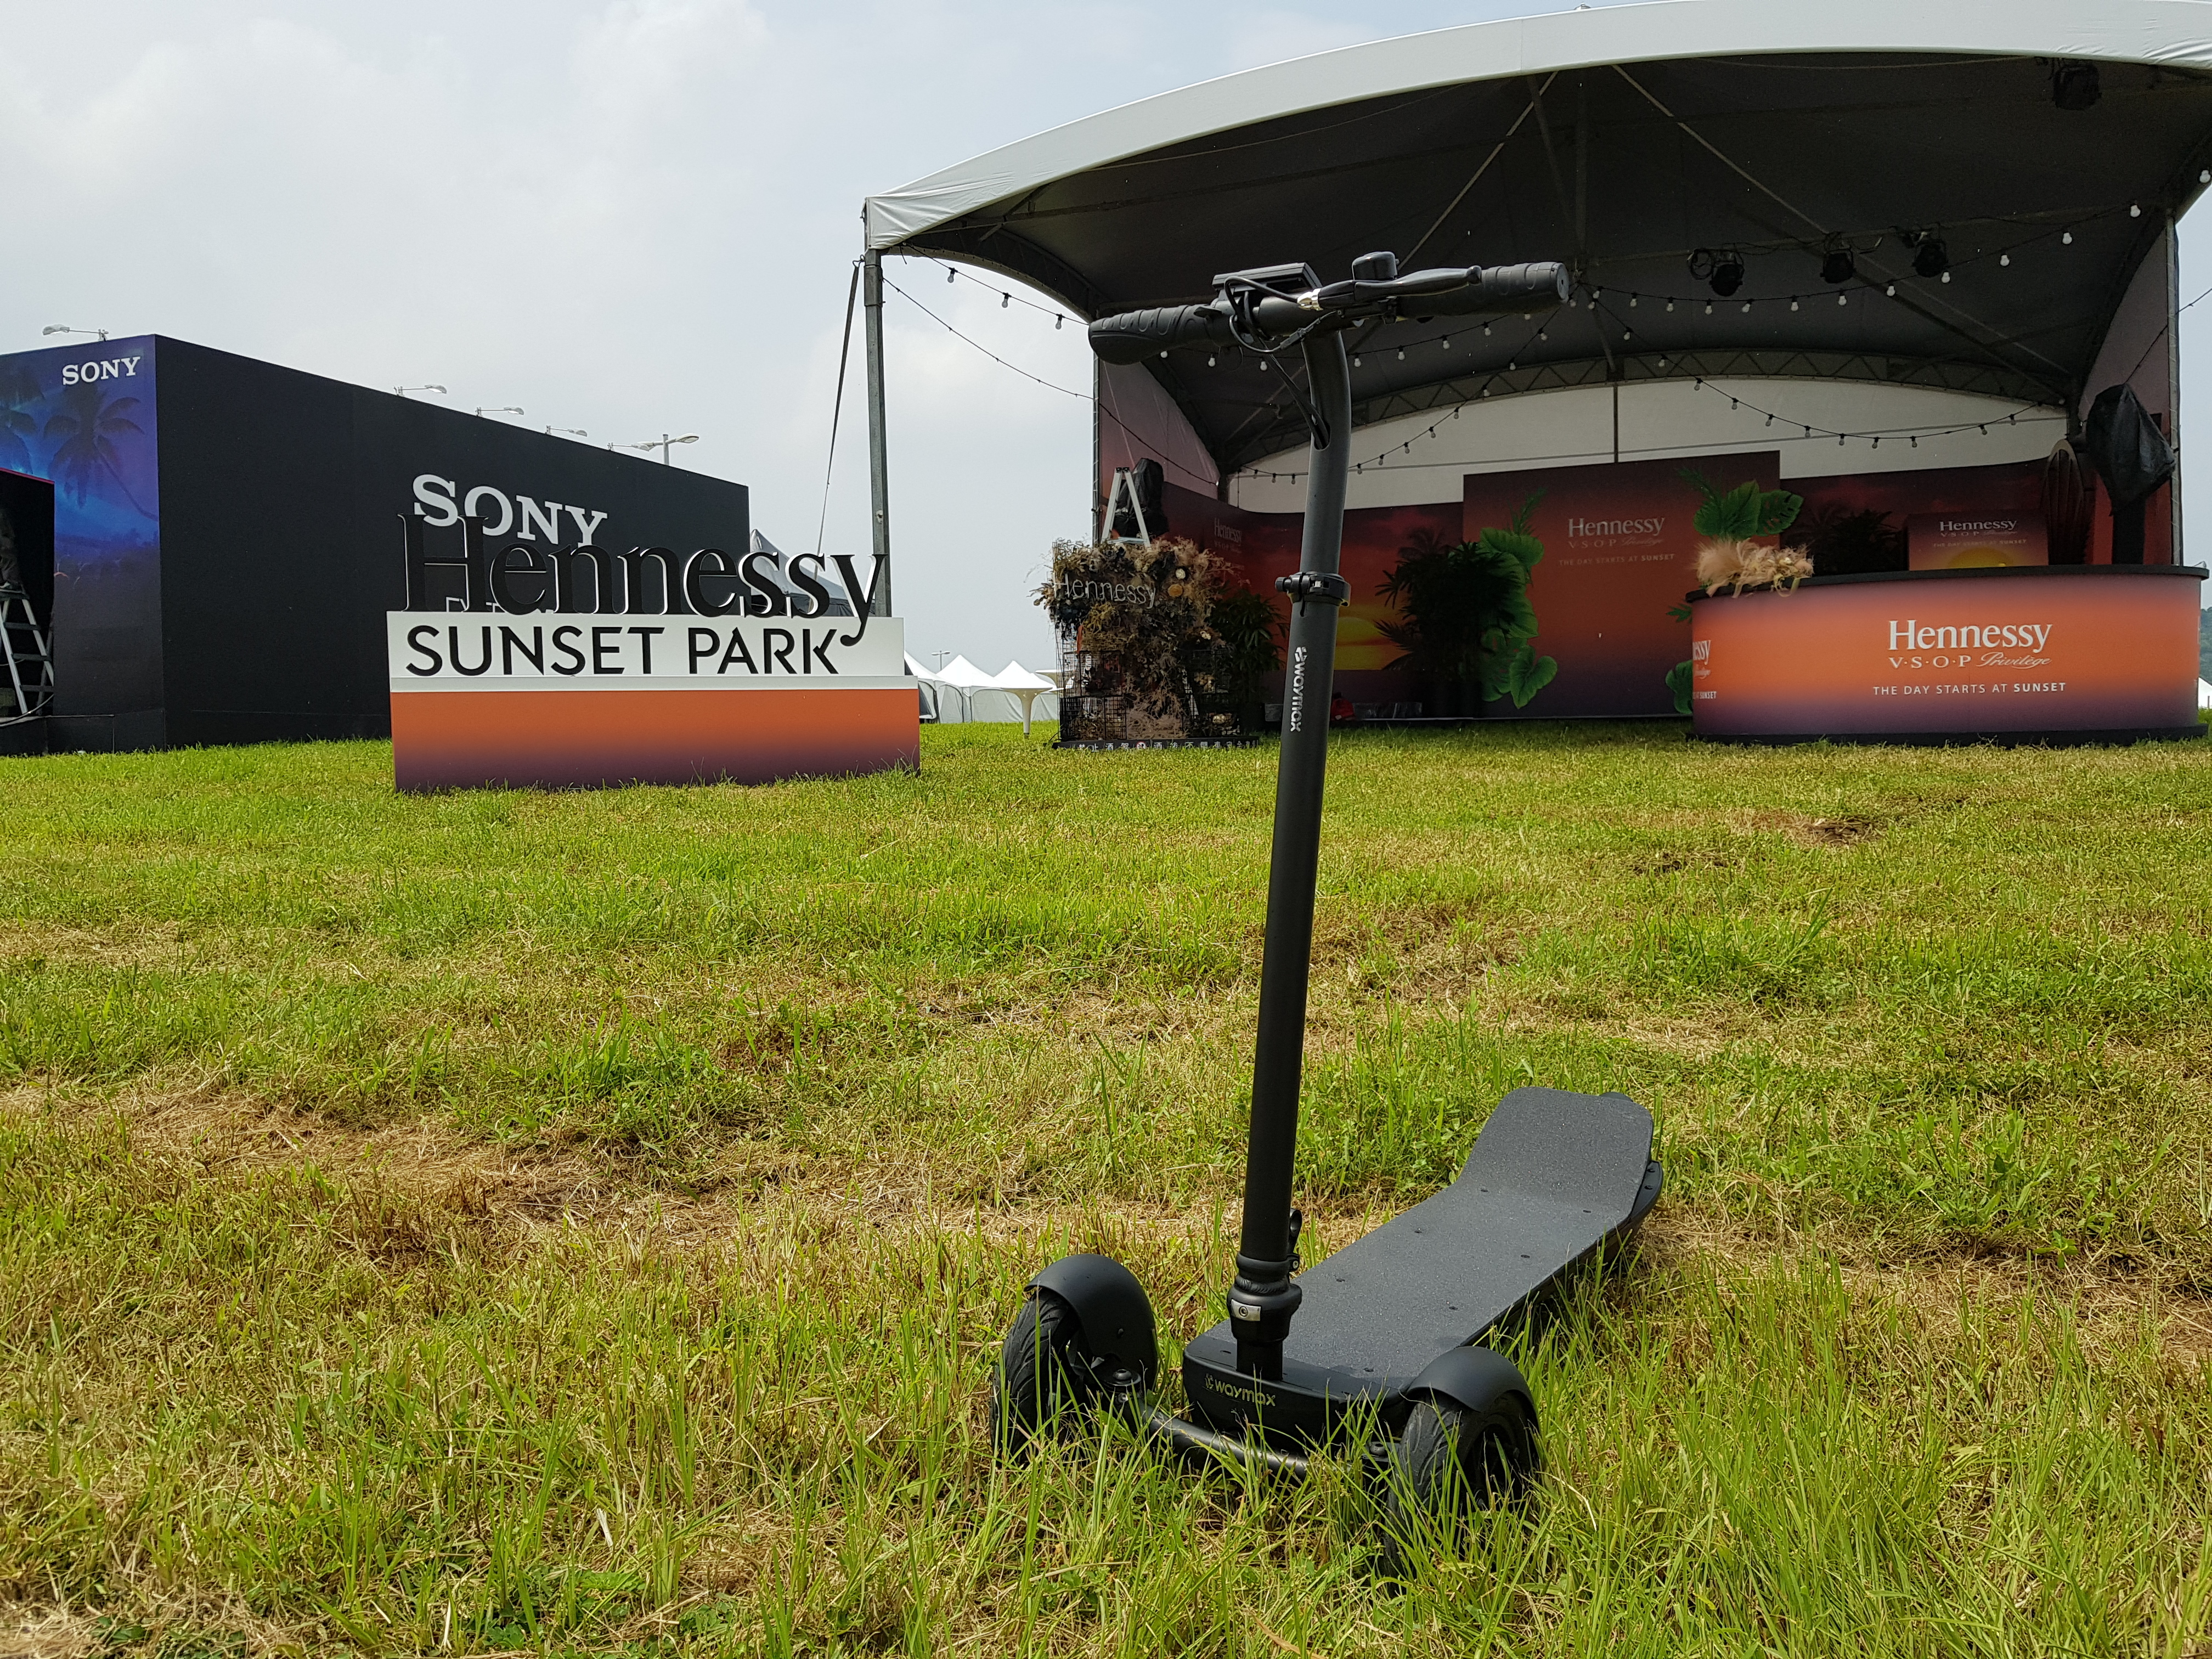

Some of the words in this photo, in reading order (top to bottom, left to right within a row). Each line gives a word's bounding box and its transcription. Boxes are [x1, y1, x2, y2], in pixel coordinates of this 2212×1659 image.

[62, 356, 140, 385] SONY
[413, 474, 608, 548] SONY
[1940, 520, 2017, 531] Hennessy
[1568, 518, 1664, 537] Hennessy
[397, 514, 887, 647] Hennessy
[1052, 572, 1155, 609] Hennessy
[405, 624, 665, 676] SUNSET
[687, 627, 839, 675] PARK
[1888, 620, 2053, 653] Hennessy
[1976, 652, 2052, 669] Privilège
[1290, 662, 1306, 732] waymax
[1874, 686, 1897, 695] THE
[1904, 685, 1929, 695] DAY
[1936, 684, 1985, 694] STARTS
[1992, 684, 2007, 693] AT
[2013, 682, 2066, 692] SUNSET
[1215, 1379, 1276, 1407] waymax
